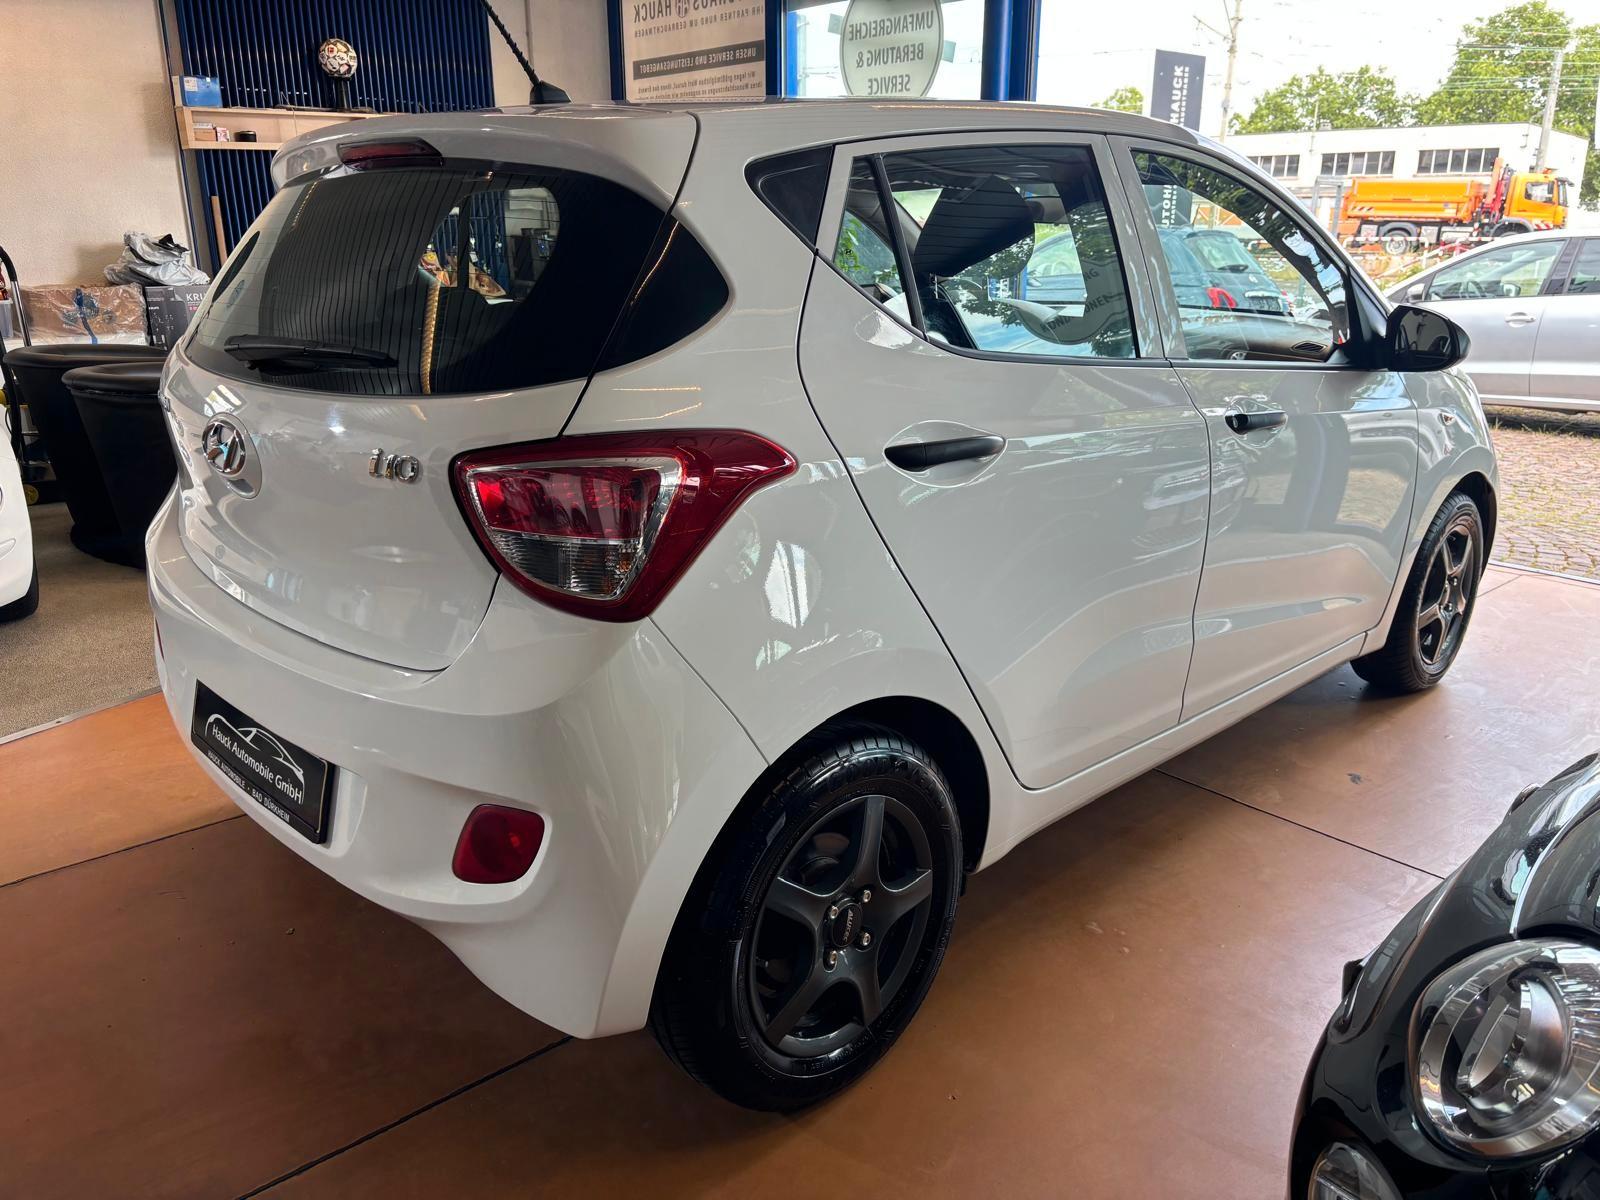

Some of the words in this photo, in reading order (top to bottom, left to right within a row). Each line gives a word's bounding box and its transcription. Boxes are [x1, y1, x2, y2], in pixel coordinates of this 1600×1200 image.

[1169, 65, 1184, 125] HAUCK
[368, 448, 420, 482] i10
[207, 750, 220, 766] HAUCK
[220, 762, 245, 789] AUTOMOBILE
[252, 788, 262, 802] BAD
[264, 796, 290, 823] DÜRKHEIM
[212, 724, 231, 750] Hauck
[231, 742, 274, 783] Automobile
[275, 775, 302, 805] GmbH
